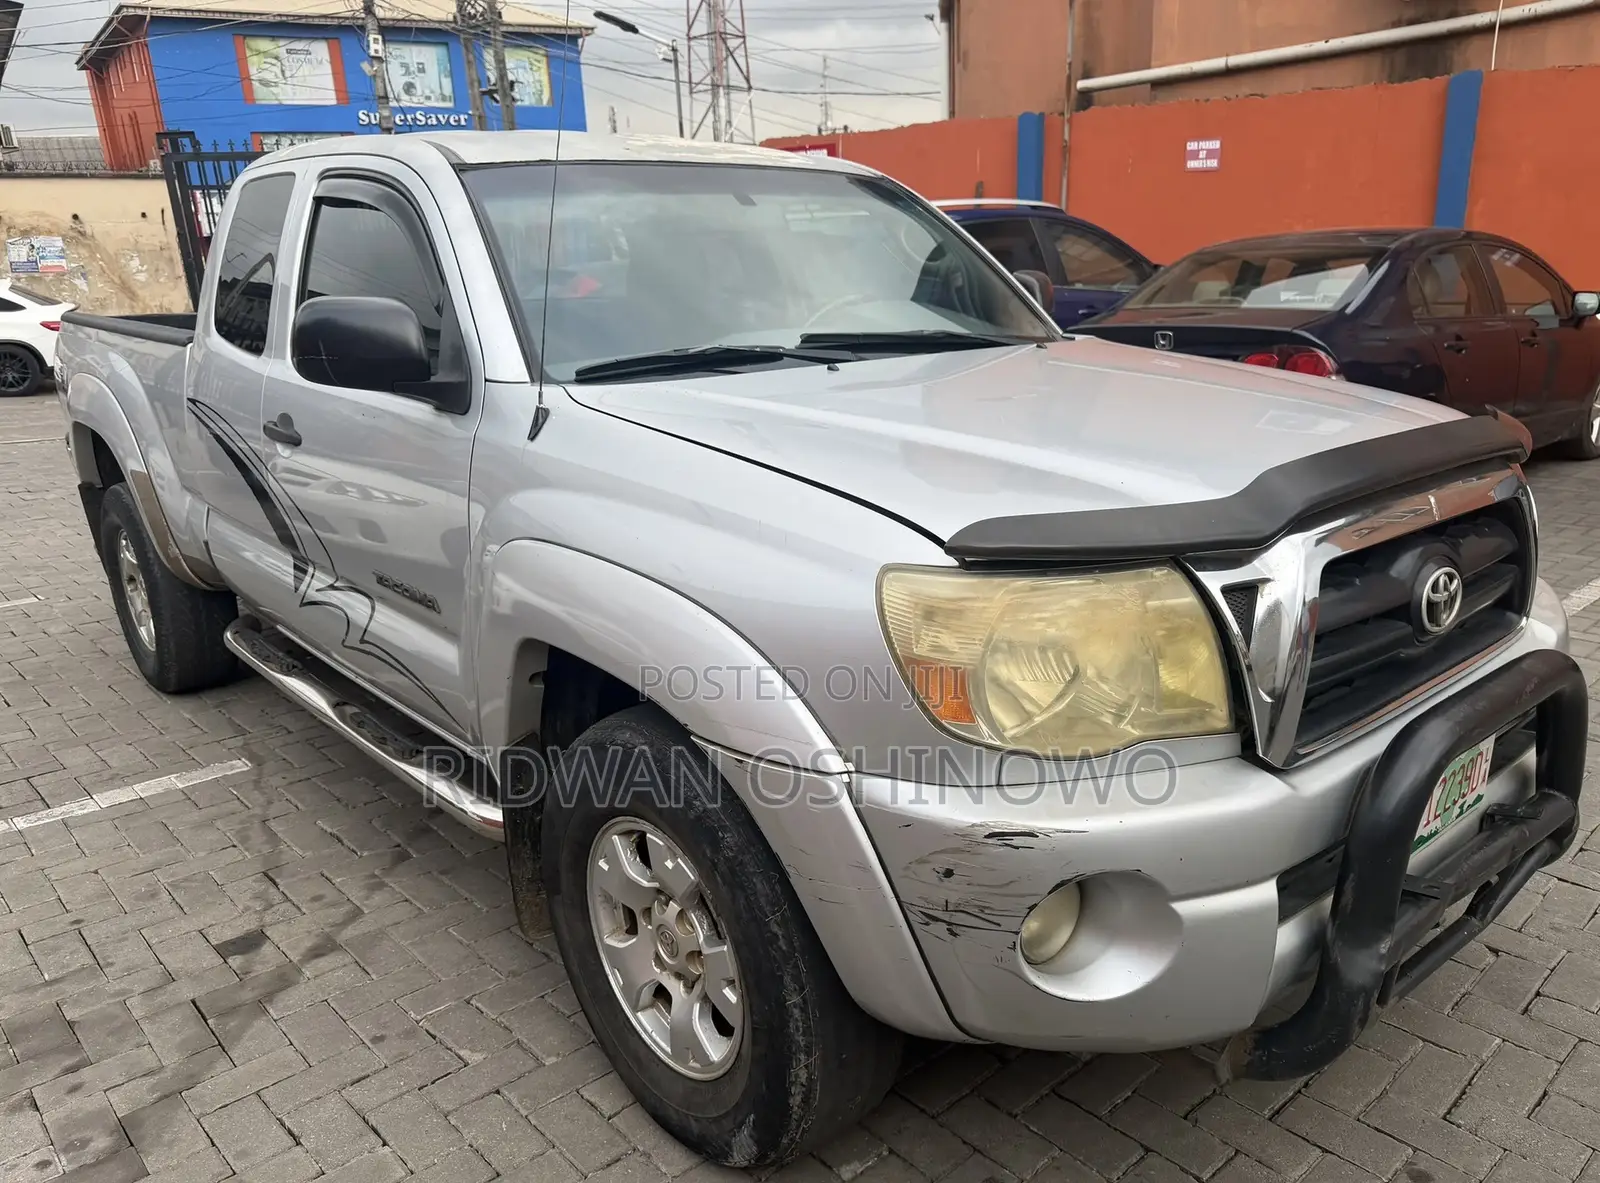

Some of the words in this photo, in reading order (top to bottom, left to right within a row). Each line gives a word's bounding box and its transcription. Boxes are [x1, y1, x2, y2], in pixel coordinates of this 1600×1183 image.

[358, 109, 468, 126] SuerSaver
[1186, 141, 1198, 150] CAR
[1199, 140, 1220, 149] PARKED
[1198, 150, 1207, 159] AT
